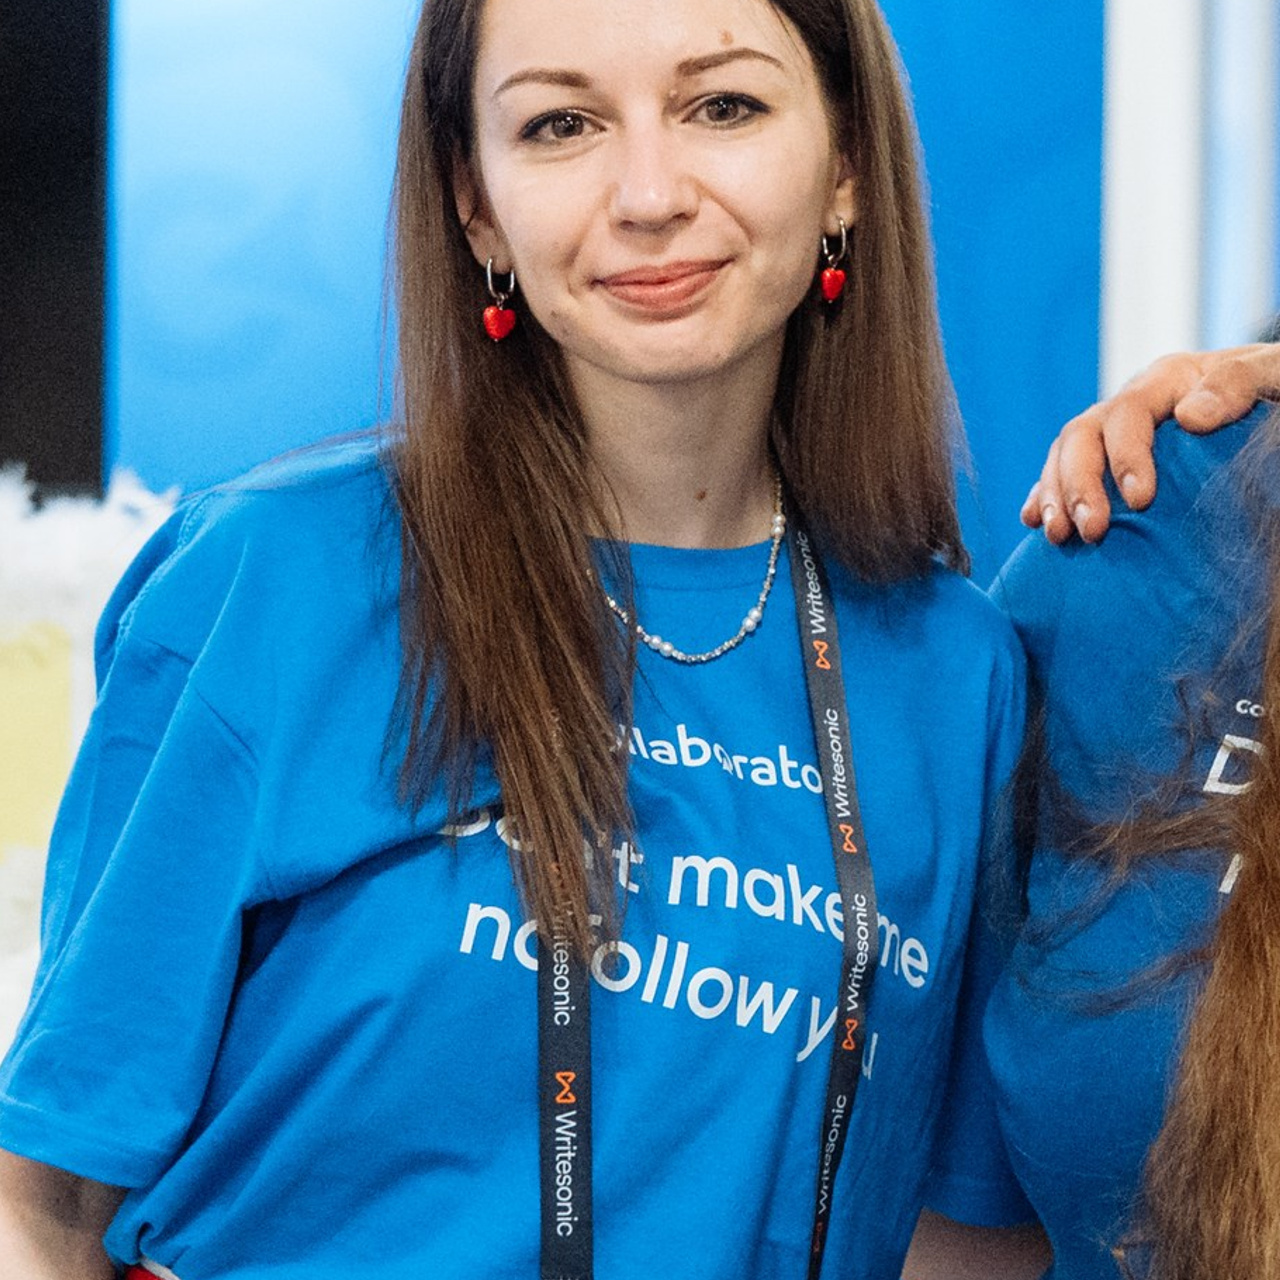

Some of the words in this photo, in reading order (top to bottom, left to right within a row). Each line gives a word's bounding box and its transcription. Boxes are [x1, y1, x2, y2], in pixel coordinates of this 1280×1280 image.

[798, 531, 827, 634] Writesonic
[823, 708, 851, 818] Writesonic
[667, 854, 845, 943] make
[846, 893, 869, 1012] Writesonic
[555, 1110, 579, 1238] Writesonic
[818, 1093, 848, 1215] Writesonic
